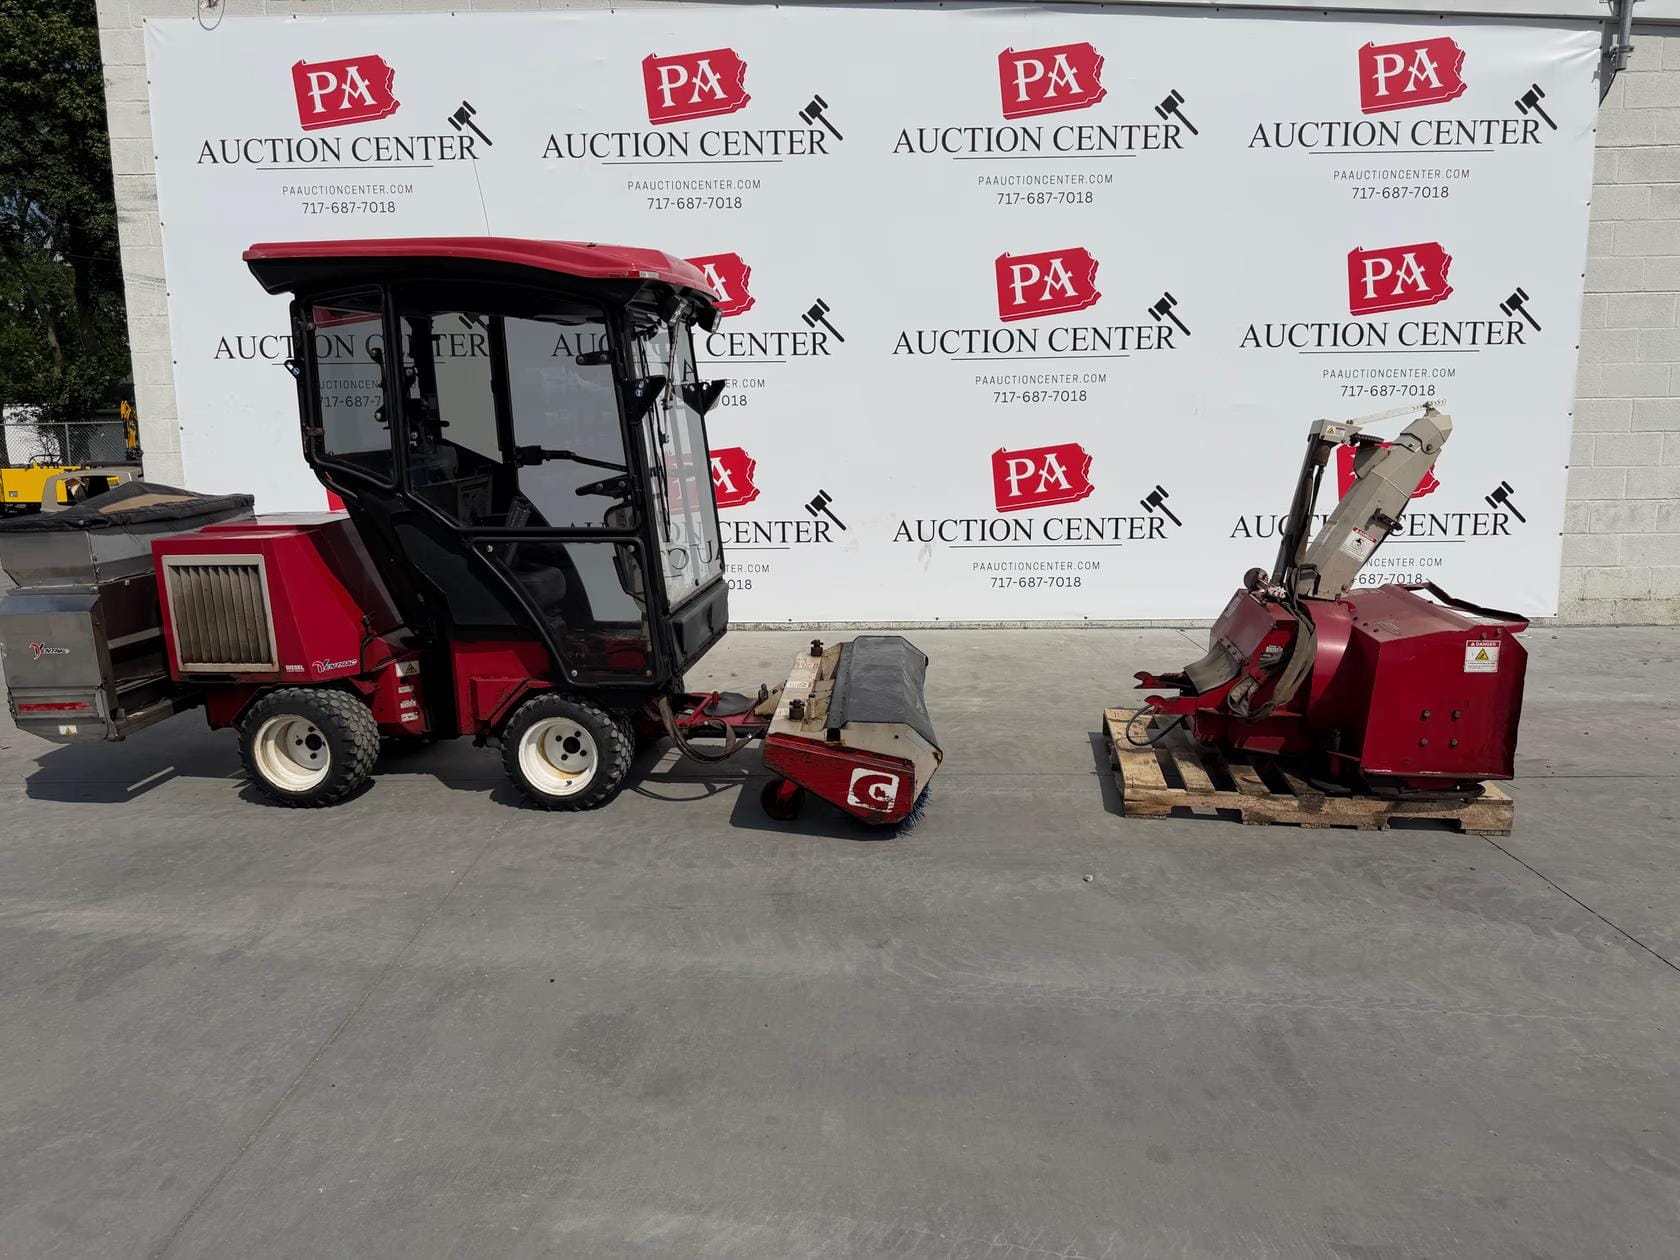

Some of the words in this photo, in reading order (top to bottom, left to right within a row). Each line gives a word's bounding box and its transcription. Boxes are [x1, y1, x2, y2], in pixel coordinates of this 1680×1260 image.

[657, 59, 728, 108] PA
[1011, 53, 1085, 102] PA
[1371, 48, 1444, 97] PA
[306, 65, 378, 114] PA
[541, 131, 691, 159] AUCTION
[699, 129, 830, 157] CENTER
[892, 126, 1044, 154] AUCTION
[1052, 124, 1184, 152] CENTER
[1247, 120, 1402, 149] AUCTION
[1410, 119, 1542, 146] CENTER
[197, 137, 342, 165] AUCTION
[351, 135, 480, 162] CENTER
[627, 179, 761, 191] PAAUCTIONCENTER.COM
[978, 174, 1113, 186] PAAUCTIONCENTER.COM
[1333, 168, 1470, 181] PAAUCTIONCENTER.COM
[282, 184, 413, 196] PAAUCTIONCENTER.COM
[996, 191, 1094, 205] 717-687-7018
[1351, 185, 1449, 200] 717-687-7018
[301, 201, 396, 215] 717-687-7018
[647, 196, 743, 210] 717-687-7018
[1008, 258, 1080, 306] PA
[1361, 252, 1431, 300] PA
[213, 334, 355, 360] AUCTON
[705, 331, 832, 357] CENTER
[891, 328, 1040, 355] AUCTION
[1048, 325, 1177, 353] CENTER
[1239, 322, 1390, 349] AUCTION
[1397, 321, 1527, 347] CENTER
[975, 373, 1107, 385] PAAUCTIONCENTER.COM
[1322, 368, 1456, 379] PAAUCTIONCENTER.COM
[993, 389, 1088, 404] 717-687-7018
[1340, 384, 1436, 398] 717-687-7018
[1004, 453, 1073, 497] PA
[719, 520, 834, 544] CENTER
[892, 518, 1035, 543] AUCTION
[1042, 516, 1168, 541] CENTER
[972, 560, 1100, 571] PAAUCTIONCENTER.COM
[990, 576, 1082, 589] 717-687-7018
[1353, 573, 1423, 585] -687-7018
